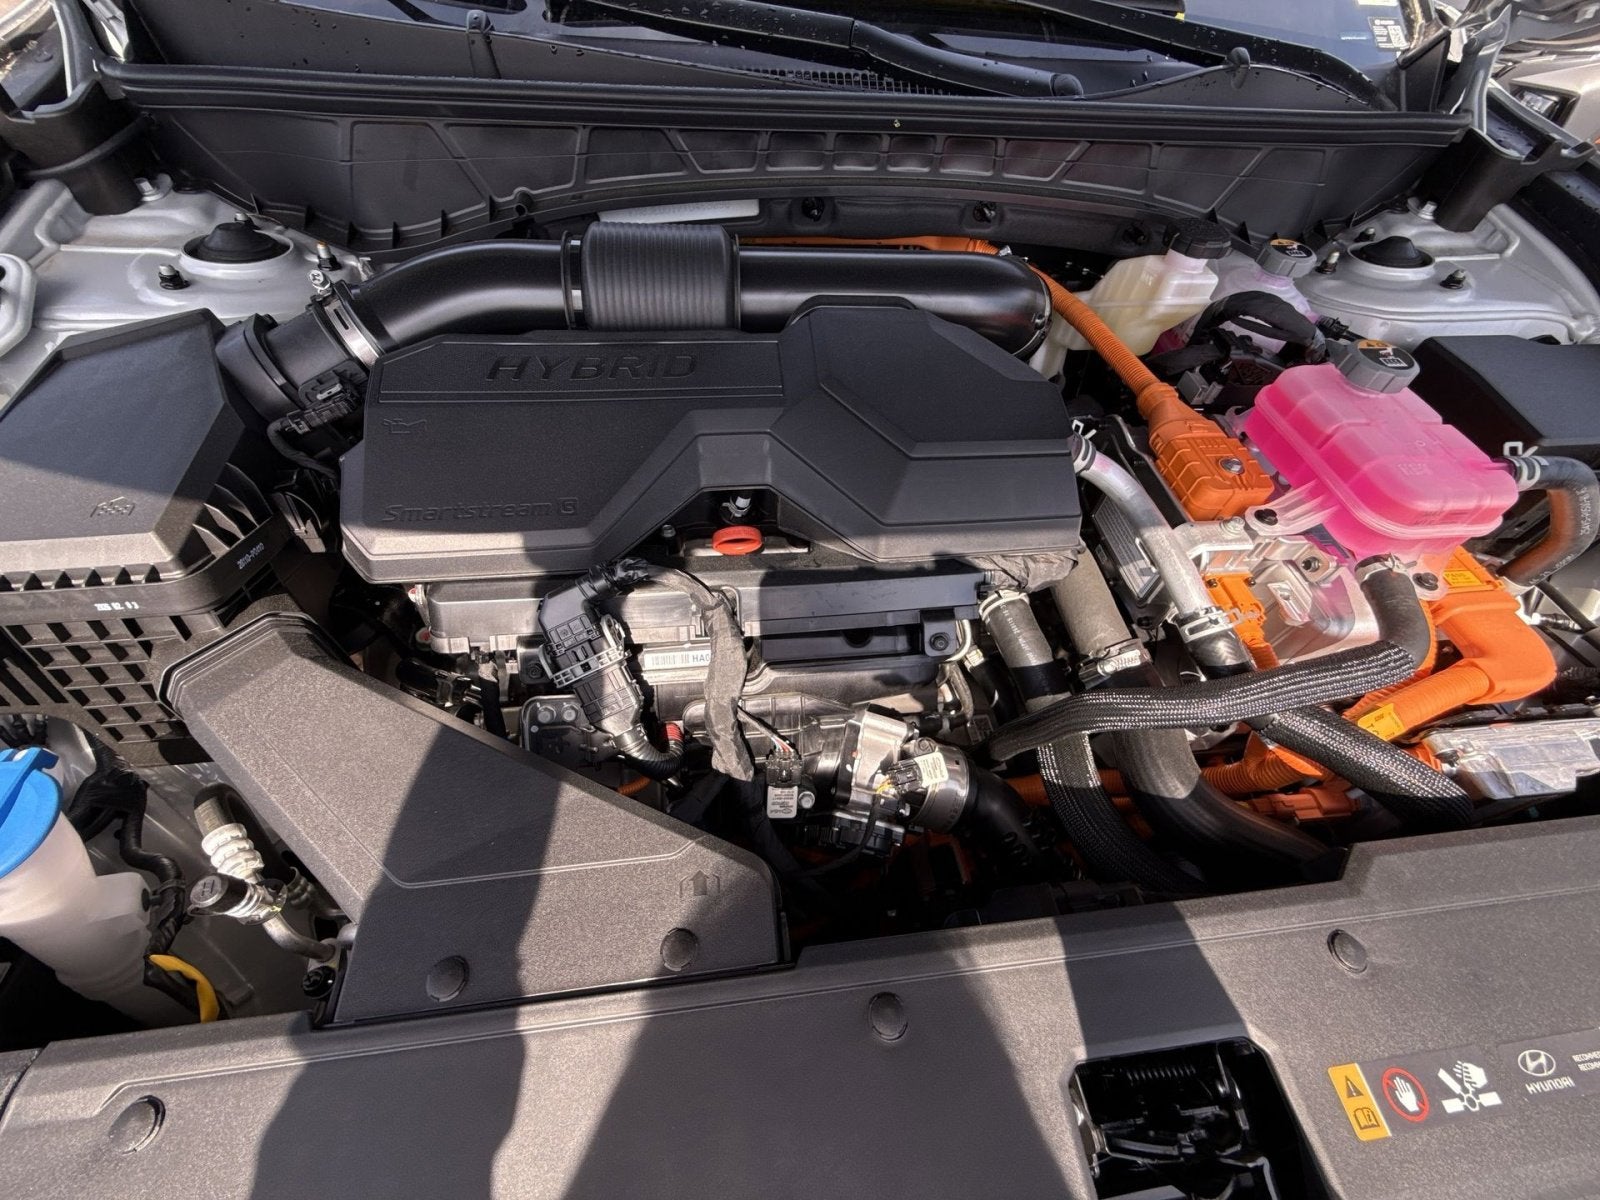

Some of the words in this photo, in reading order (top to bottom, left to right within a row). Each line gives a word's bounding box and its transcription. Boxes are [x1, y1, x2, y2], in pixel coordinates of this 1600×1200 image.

[486, 355, 699, 381] HYBRID
[382, 502, 553, 522] Smartstream
[557, 496, 579, 517] G
[1525, 1076, 1576, 1094] HYUNDAI
